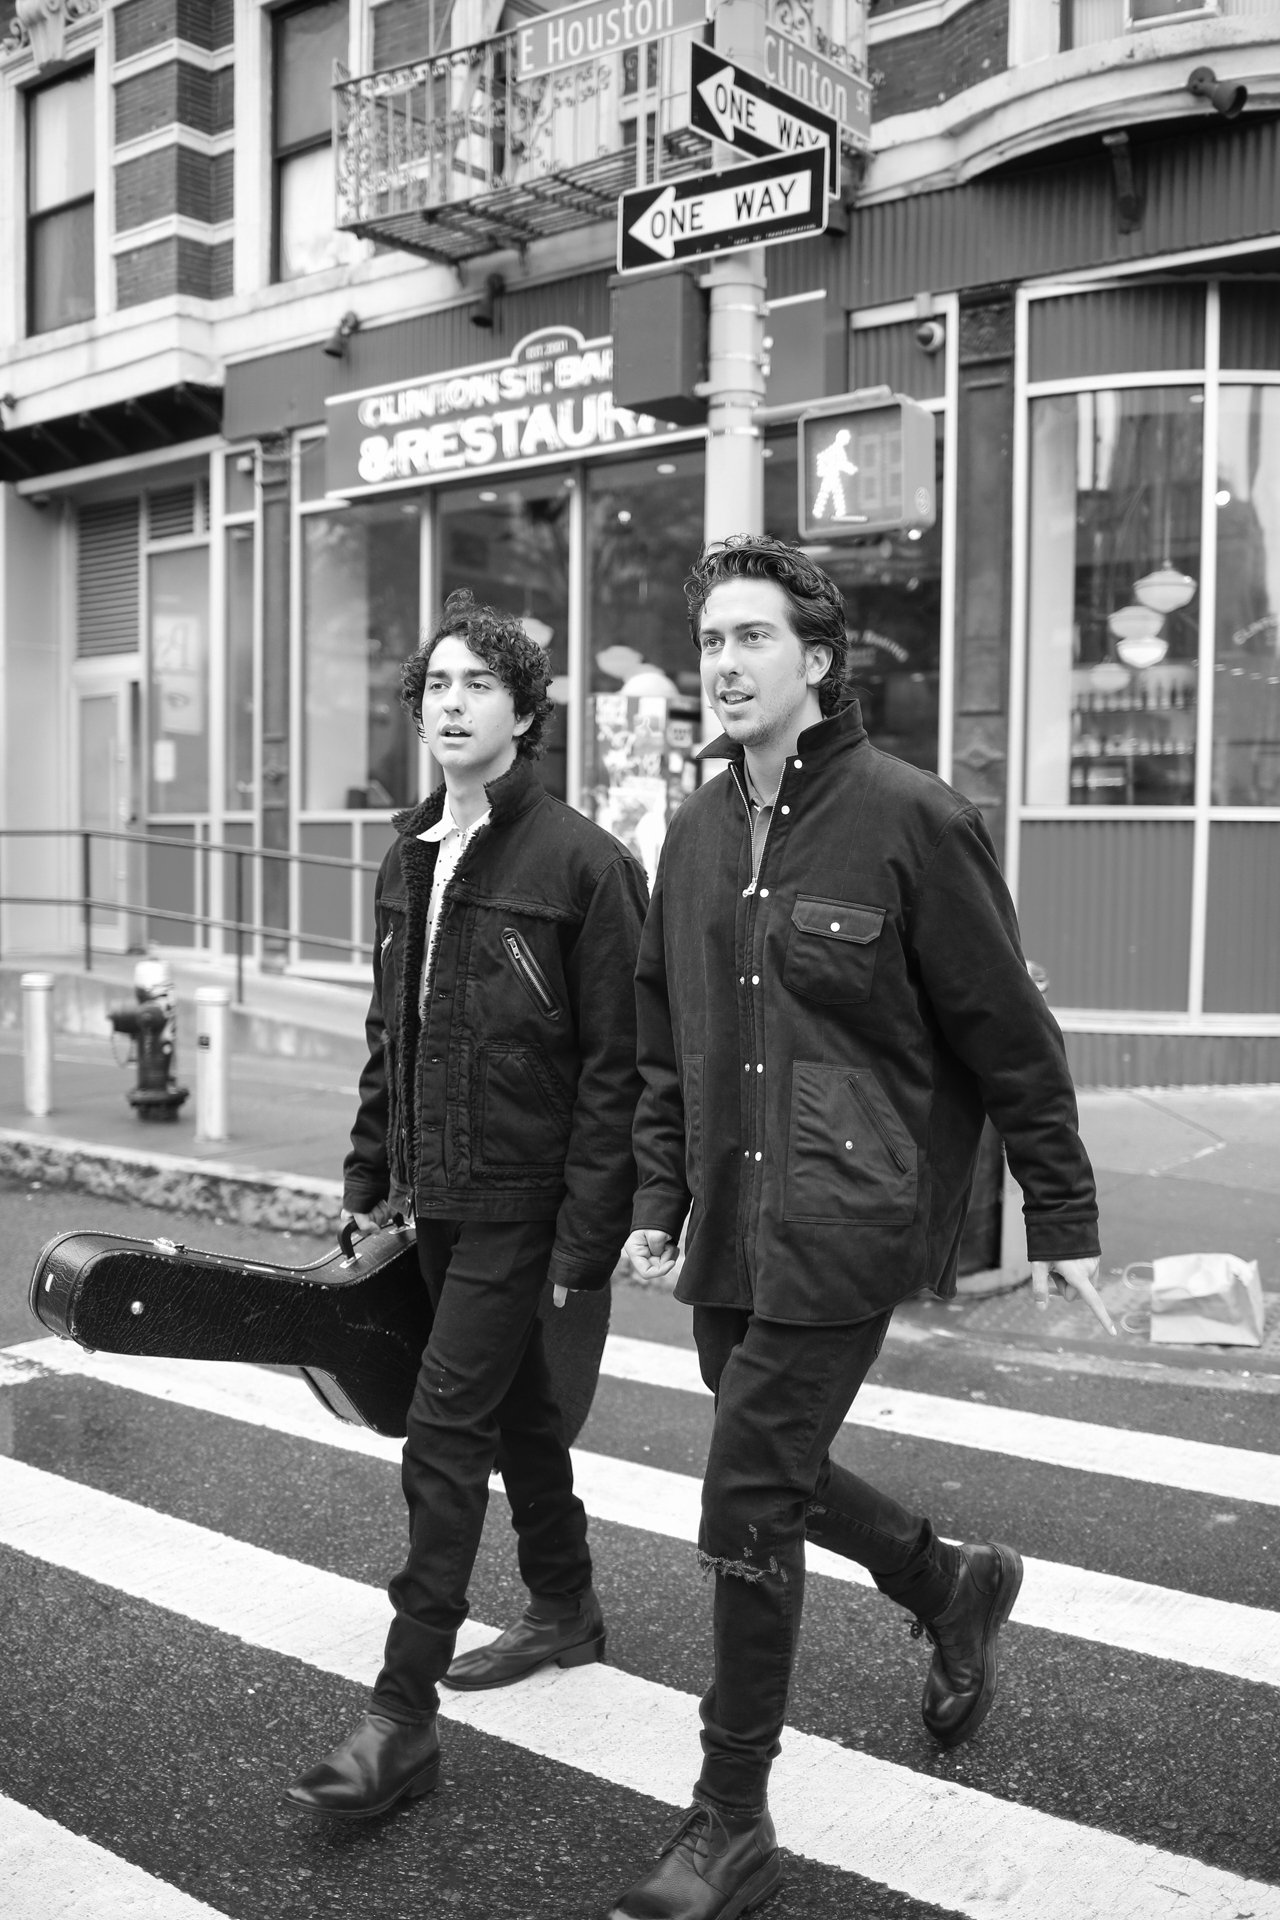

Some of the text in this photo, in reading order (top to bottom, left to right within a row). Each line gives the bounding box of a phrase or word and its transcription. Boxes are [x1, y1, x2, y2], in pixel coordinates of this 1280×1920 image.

[521, 0, 673, 72] E Houston
[715, 83, 756, 132] ONE
[764, 35, 847, 122] Clinton
[651, 201, 703, 239] ONE
[735, 179, 796, 221] WAY
[358, 372, 500, 429] CLINTON
